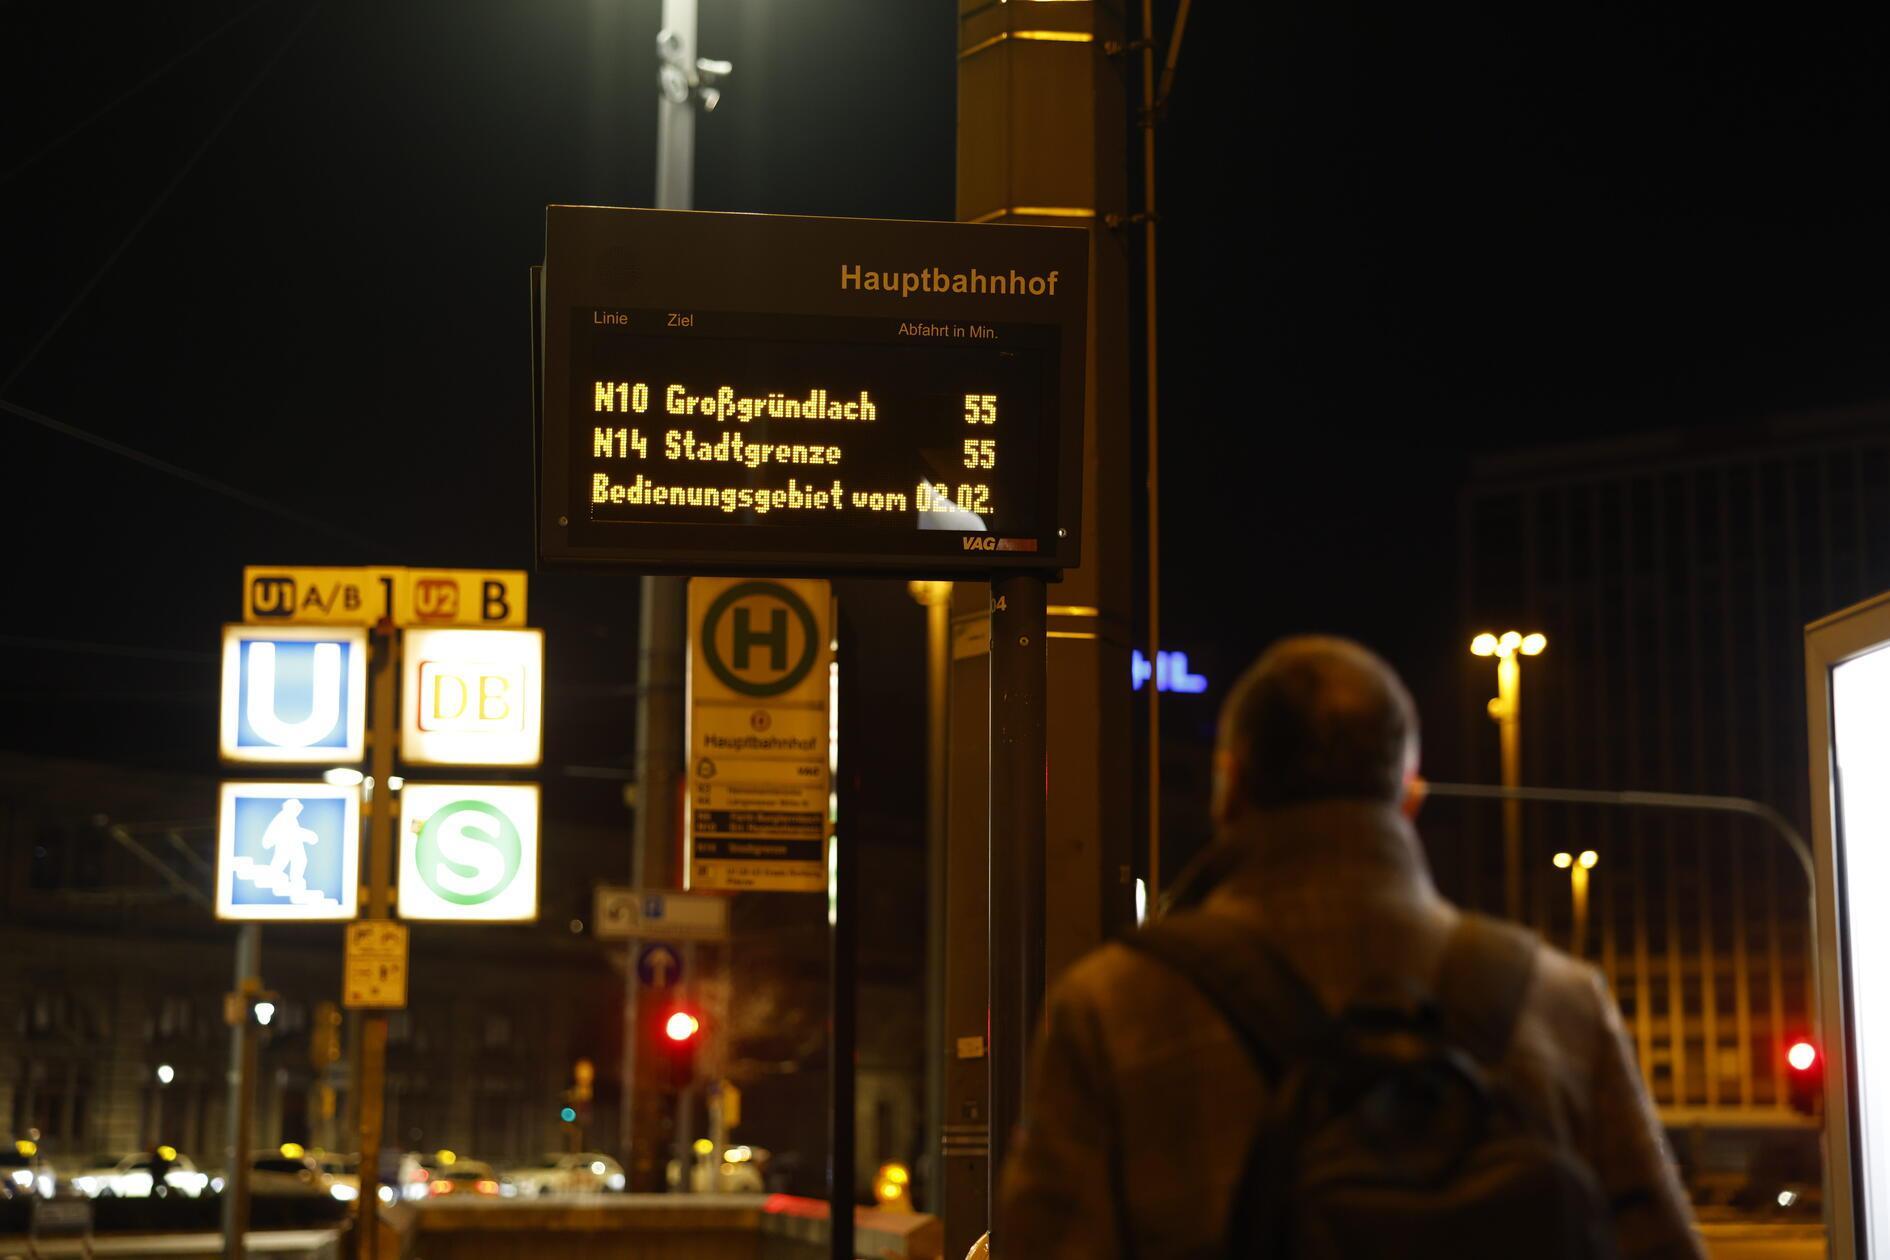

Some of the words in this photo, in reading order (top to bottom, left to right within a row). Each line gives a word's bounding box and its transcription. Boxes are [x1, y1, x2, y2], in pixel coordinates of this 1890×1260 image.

[841, 265, 1059, 298] Hauptbahnhof
[594, 311, 628, 325] Linie
[667, 313, 694, 327] Ziel
[898, 322, 949, 337] Abfahrt
[953, 324, 965, 338] in
[969, 325, 999, 339] Min.
[594, 381, 649, 413] N10
[666, 384, 876, 423] Großgründlach
[964, 395, 997, 425] 55
[593, 427, 648, 459] N14
[665, 429, 842, 469] Stadtgrenze
[963, 440, 996, 470] 55
[592, 472, 844, 514] Bedienungsgebiet
[852, 491, 907, 512] vom
[916, 482, 994, 514] 02.02.
[962, 537, 996, 552] VAG
[254, 581, 294, 613] U1
[301, 581, 363, 614] A/B
[417, 582, 458, 617] U2
[481, 580, 510, 621] B
[732, 606, 788, 671] H
[246, 641, 342, 747] U
[432, 673, 511, 722] DB
[435, 810, 505, 896] S
